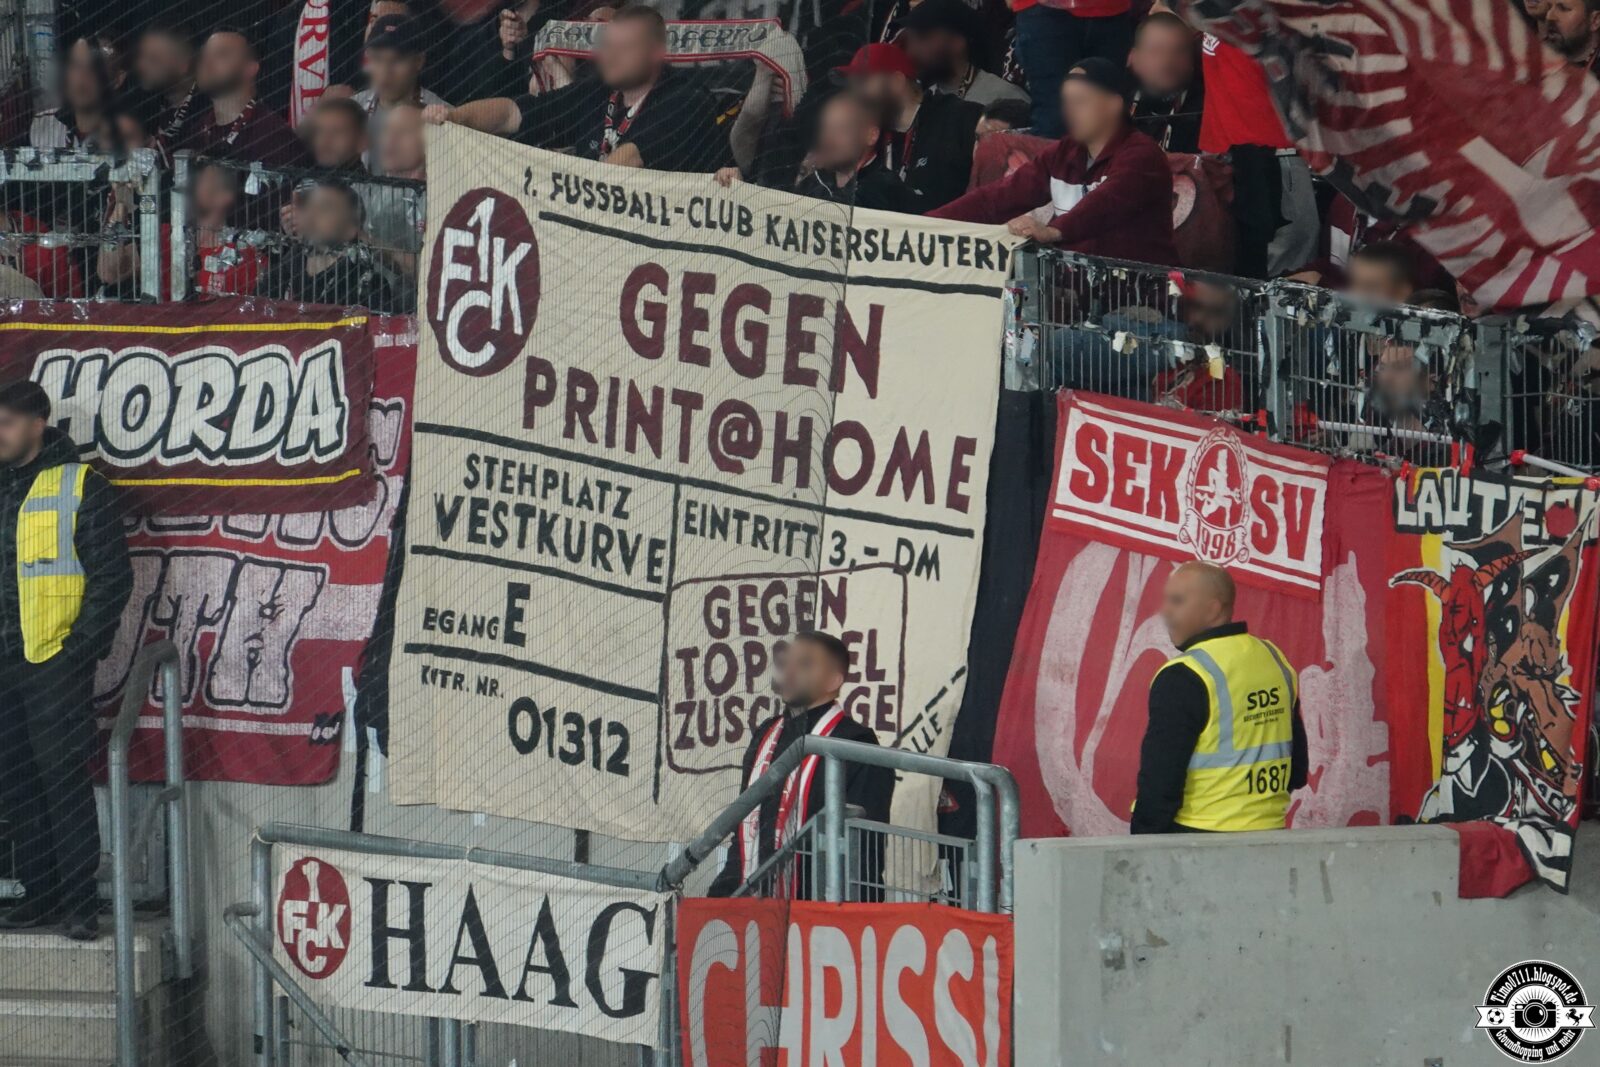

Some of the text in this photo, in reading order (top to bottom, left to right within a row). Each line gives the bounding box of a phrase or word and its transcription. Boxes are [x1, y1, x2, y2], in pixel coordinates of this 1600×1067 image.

[549, 171, 754, 237] FUSSBALL-CLUB
[765, 213, 1010, 272] KAISERSLAUTERN
[619, 262, 885, 399] GEGEN
[29, 338, 348, 467] HORDA
[522, 355, 978, 514] PRINT@HOME
[463, 452, 633, 520] STEHPLATZ
[1069, 421, 1317, 562] SEK 1998 SV
[683, 499, 819, 559] EINTRITT
[892, 536, 941, 582] DM
[503, 581, 531, 648] E
[703, 576, 848, 640] GEGEN
[508, 696, 631, 777] 01312
[1246, 687, 1280, 711] SDS
[1245, 763, 1288, 795] 1687
[362, 876, 661, 1019] HAAG
[688, 918, 1001, 1067] CHRISSI
